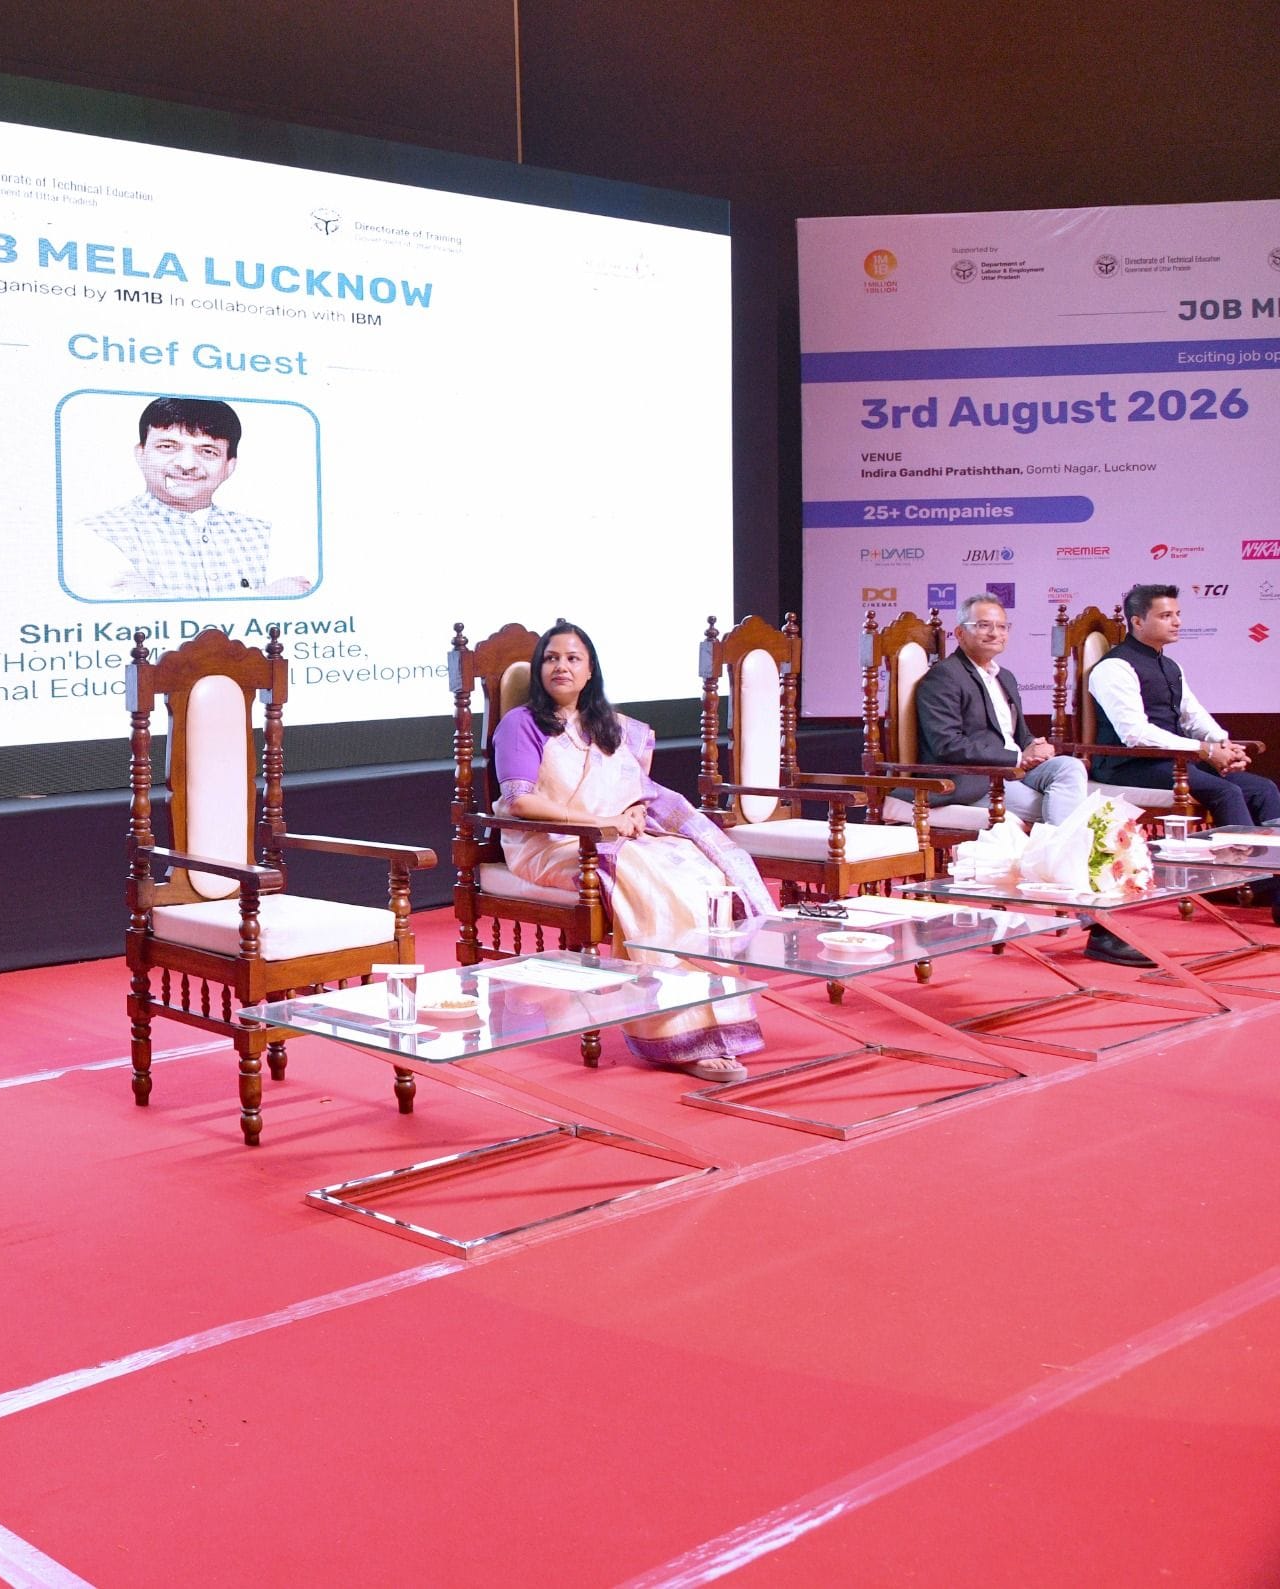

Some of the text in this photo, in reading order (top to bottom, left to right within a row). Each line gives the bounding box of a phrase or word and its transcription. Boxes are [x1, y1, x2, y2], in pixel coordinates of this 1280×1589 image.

[35, 176, 47, 187] of
[52, 177, 103, 196] Technical
[106, 186, 154, 202] Education
[355, 221, 410, 237] Directorate
[413, 229, 422, 238] of
[426, 230, 462, 246] Training
[1125, 255, 1221, 265] Directorate of Technical Education
[38, 238, 189, 283] MELA
[204, 256, 433, 309] LUCKNOW
[83, 285, 107, 304] by
[113, 288, 164, 306] 1M1B
[170, 293, 186, 307] In
[191, 294, 308, 320] collaboration
[312, 307, 346, 324] with
[350, 311, 383, 326] IBM
[1178, 299, 1243, 321] JOB
[67, 333, 309, 376] Chief Guest
[1178, 350, 1235, 365] Exciting
[1238, 349, 1261, 365] job
[861, 387, 1250, 434] 3rd August 2026
[861, 452, 902, 463] VENUE
[861, 467, 897, 479] Indira
[899, 465, 943, 478] Gandhi
[945, 464, 1024, 478] Pratishthan,
[1026, 463, 1061, 475] Gomti
[1104, 461, 1157, 474] Lucknow
[863, 503, 1014, 523] 25+ Companies
[962, 549, 996, 562] JBM
[1056, 546, 1111, 556] PREMIER
[1171, 545, 1205, 554] Payments
[1204, 584, 1230, 596] TCI
[19, 622, 83, 644] Shri
[94, 620, 170, 643] Kapil
[180, 620, 235, 639] Dv
[4, 650, 122, 673] Hon'ble
[293, 640, 369, 661] State,
[306, 663, 448, 685] Developme
